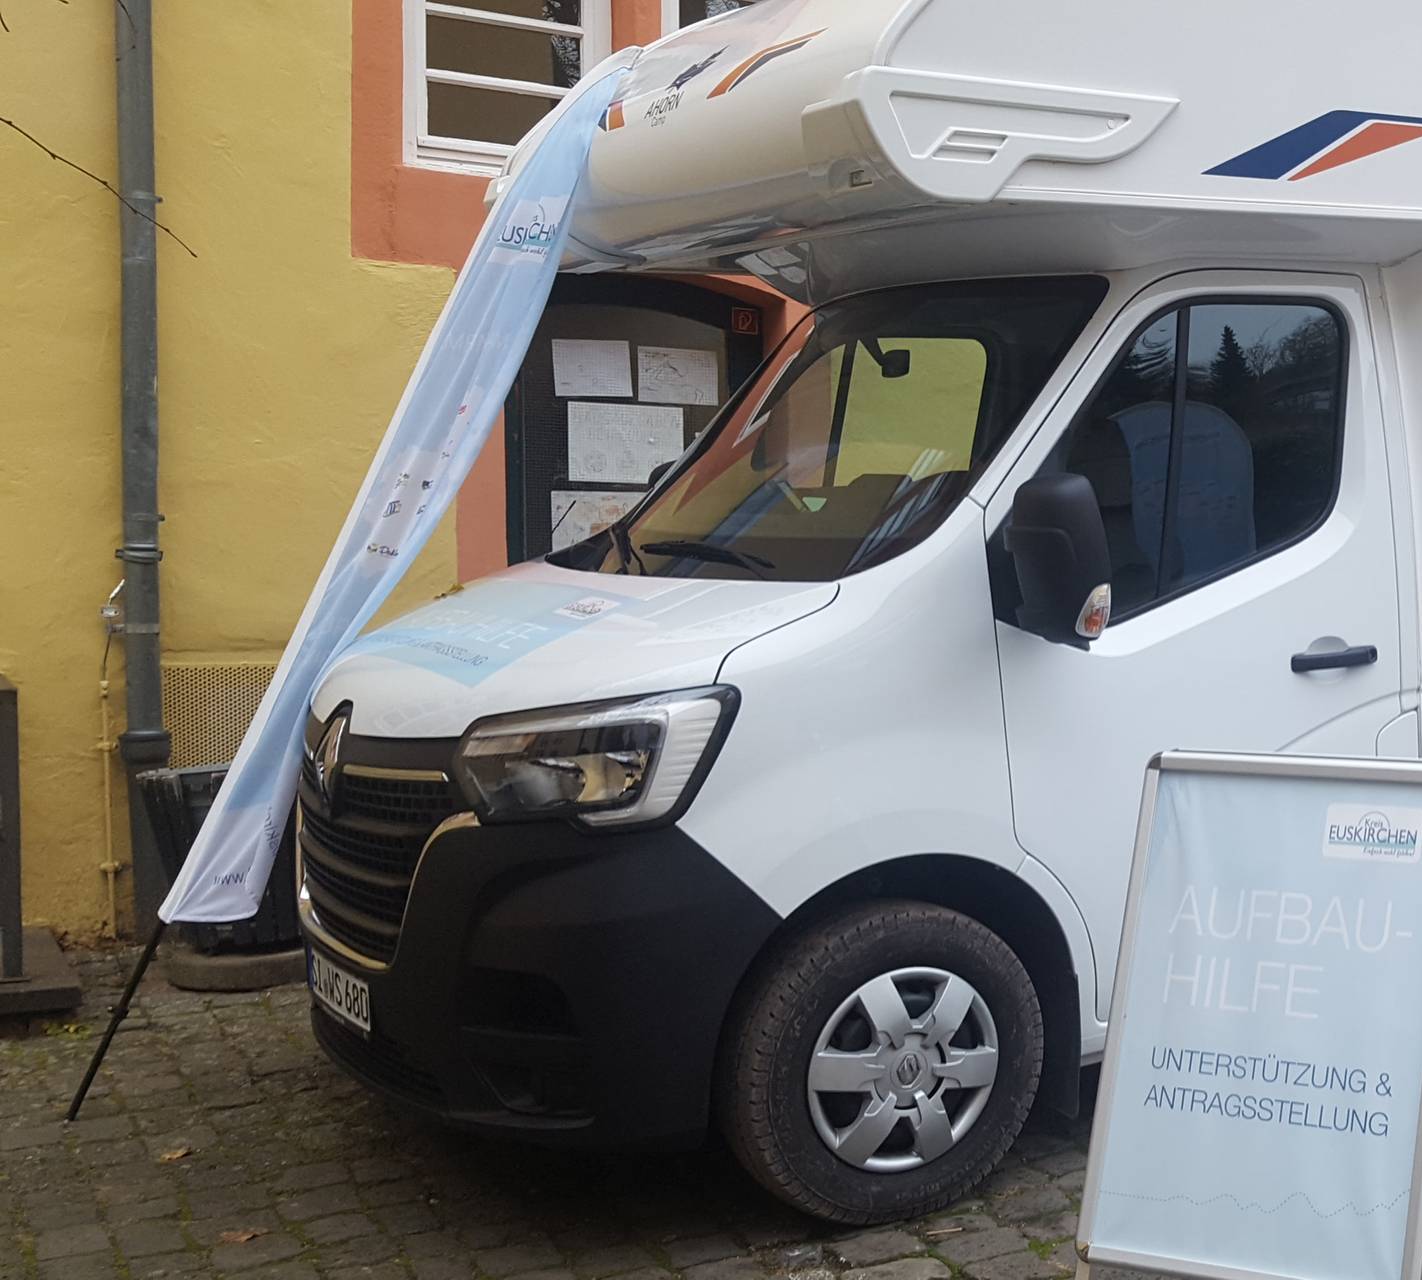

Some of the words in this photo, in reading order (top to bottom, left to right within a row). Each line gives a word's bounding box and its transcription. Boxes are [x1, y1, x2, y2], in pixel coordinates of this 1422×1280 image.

[644, 90, 685, 119] AHORN
[1328, 823, 1418, 846] EUSKIRCHEN
[1364, 817, 1384, 828] Kreis
[1168, 884, 1413, 953] AUFBAU-
[344, 979, 369, 1023] 680
[1162, 953, 1325, 1019] HILFE
[1150, 1046, 1367, 1094] UNTERSTÜTZUNG
[1375, 1072, 1393, 1097] &
[1143, 1084, 1390, 1138] ANTRAGSSTELLUNG
